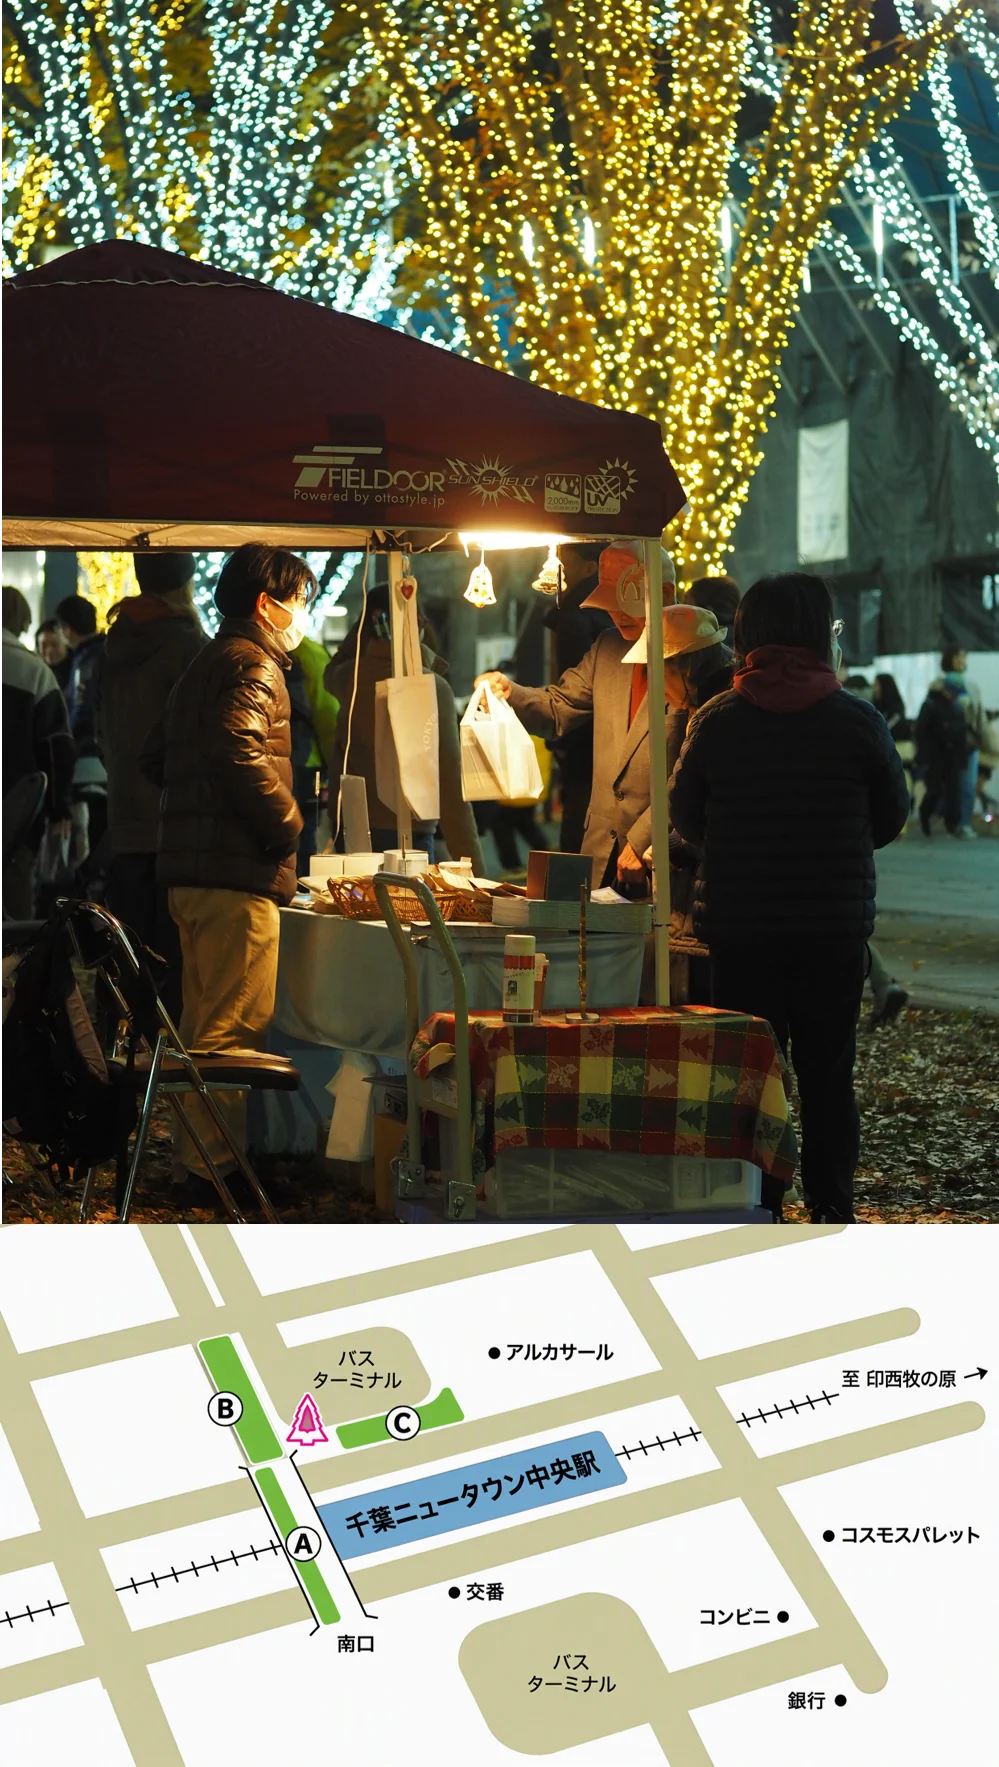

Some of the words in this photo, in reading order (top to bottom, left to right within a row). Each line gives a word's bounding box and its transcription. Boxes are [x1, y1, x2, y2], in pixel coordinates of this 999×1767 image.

[328, 467, 446, 492] FIELDOOR
[448, 474, 480, 485] SUN
[481, 476, 536, 487] SHIELD
[294, 489, 349, 501] Powered
[355, 490, 370, 505] by
[375, 492, 445, 508] ottostyle.jp
[587, 492, 609, 507] UV
